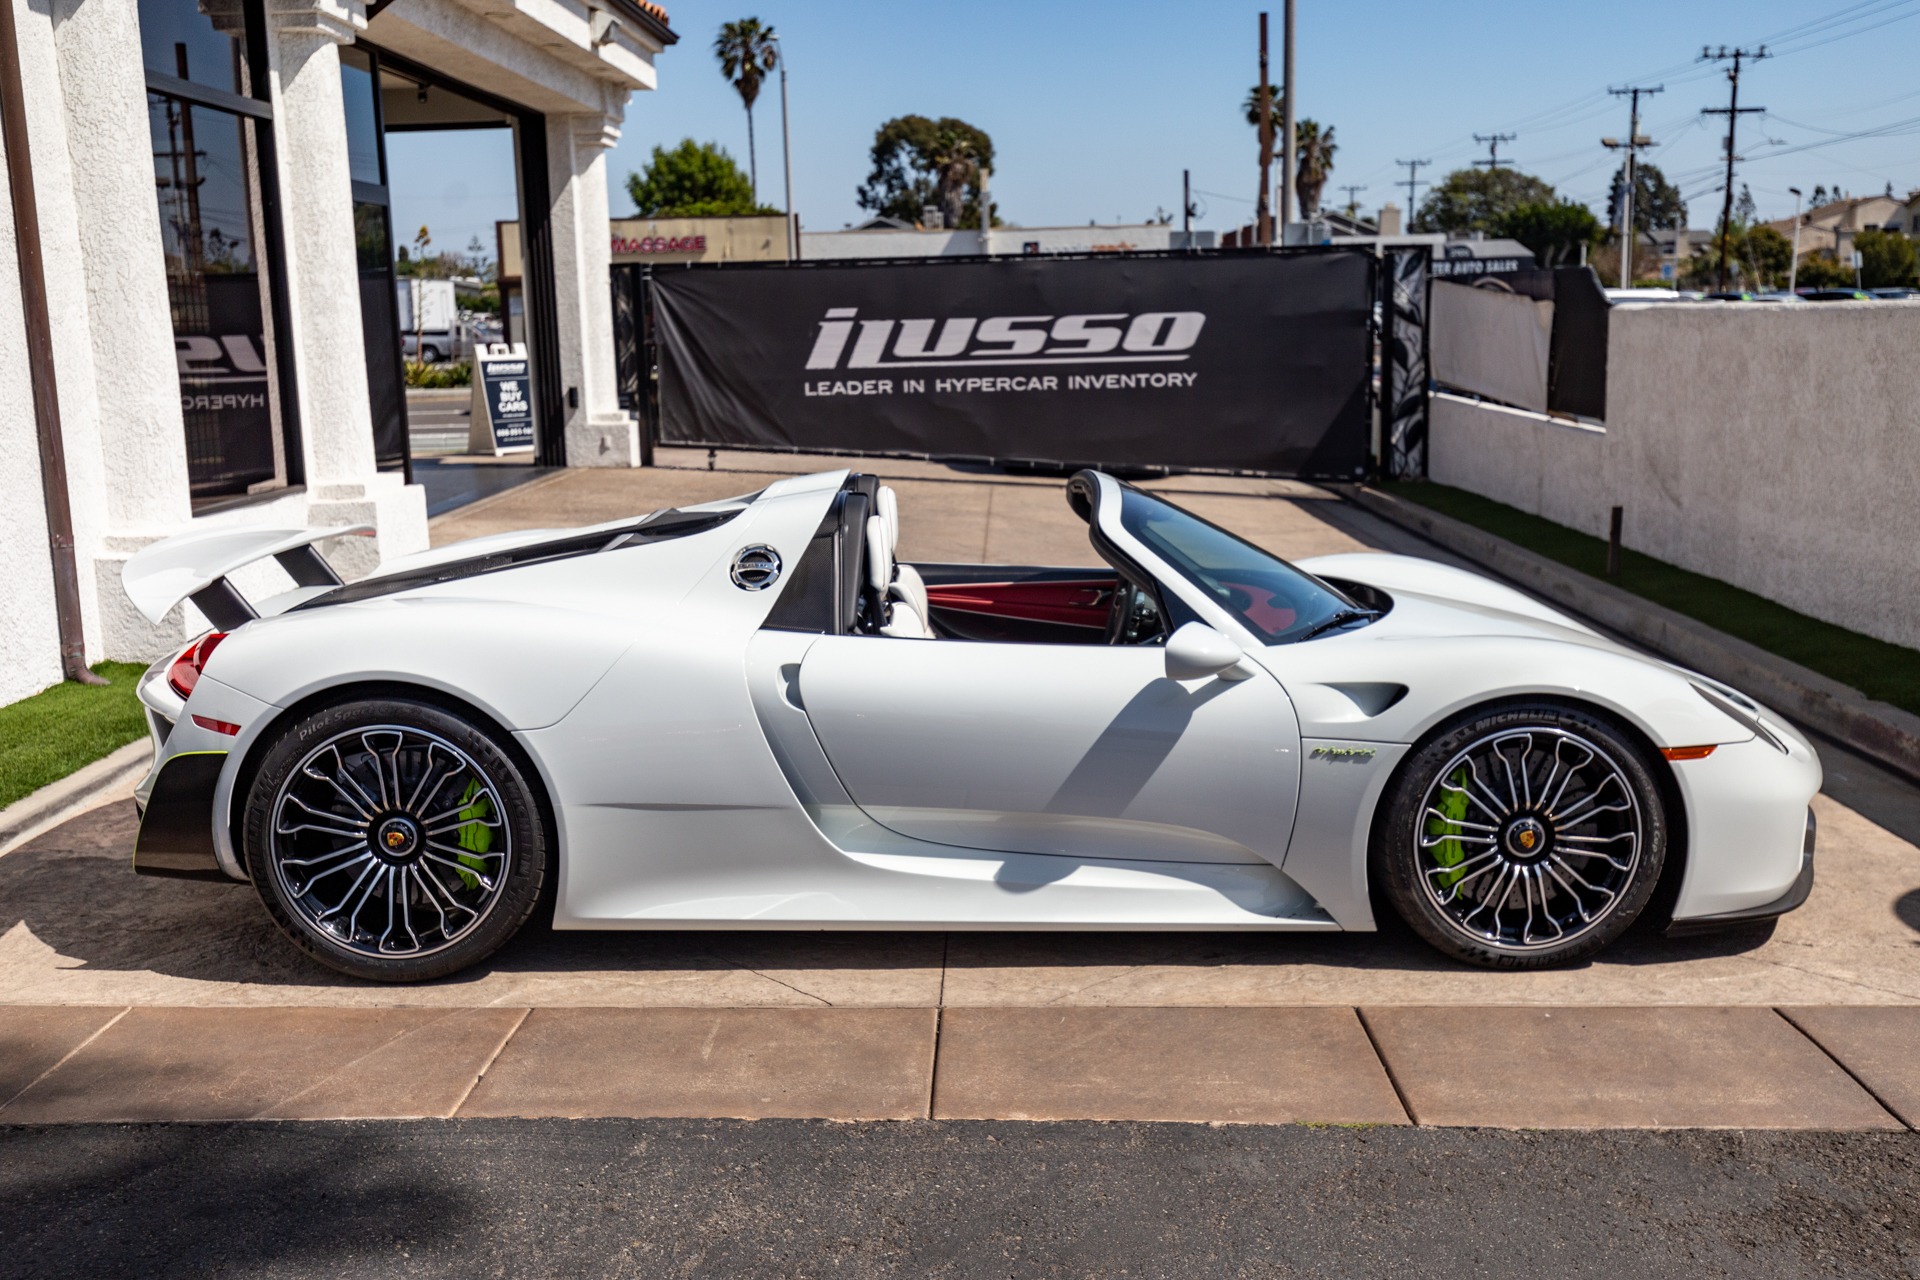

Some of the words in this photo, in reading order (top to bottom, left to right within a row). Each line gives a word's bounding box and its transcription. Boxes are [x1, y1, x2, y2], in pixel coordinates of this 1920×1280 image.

[611, 235, 707, 254] MASSAGE
[1453, 260, 1484, 275] AUTO
[1485, 259, 1519, 272] SALES
[499, 381, 518, 393] WE
[804, 379, 893, 397] LEADER
[902, 379, 925, 394] IN
[935, 375, 1058, 393] HYPERCAR
[1068, 372, 1198, 390] INVENTORY
[500, 391, 522, 402] BUY
[498, 401, 528, 413] CARS
[299, 717, 331, 740] Pilot
[1475, 709, 1559, 731] MICHELIN
